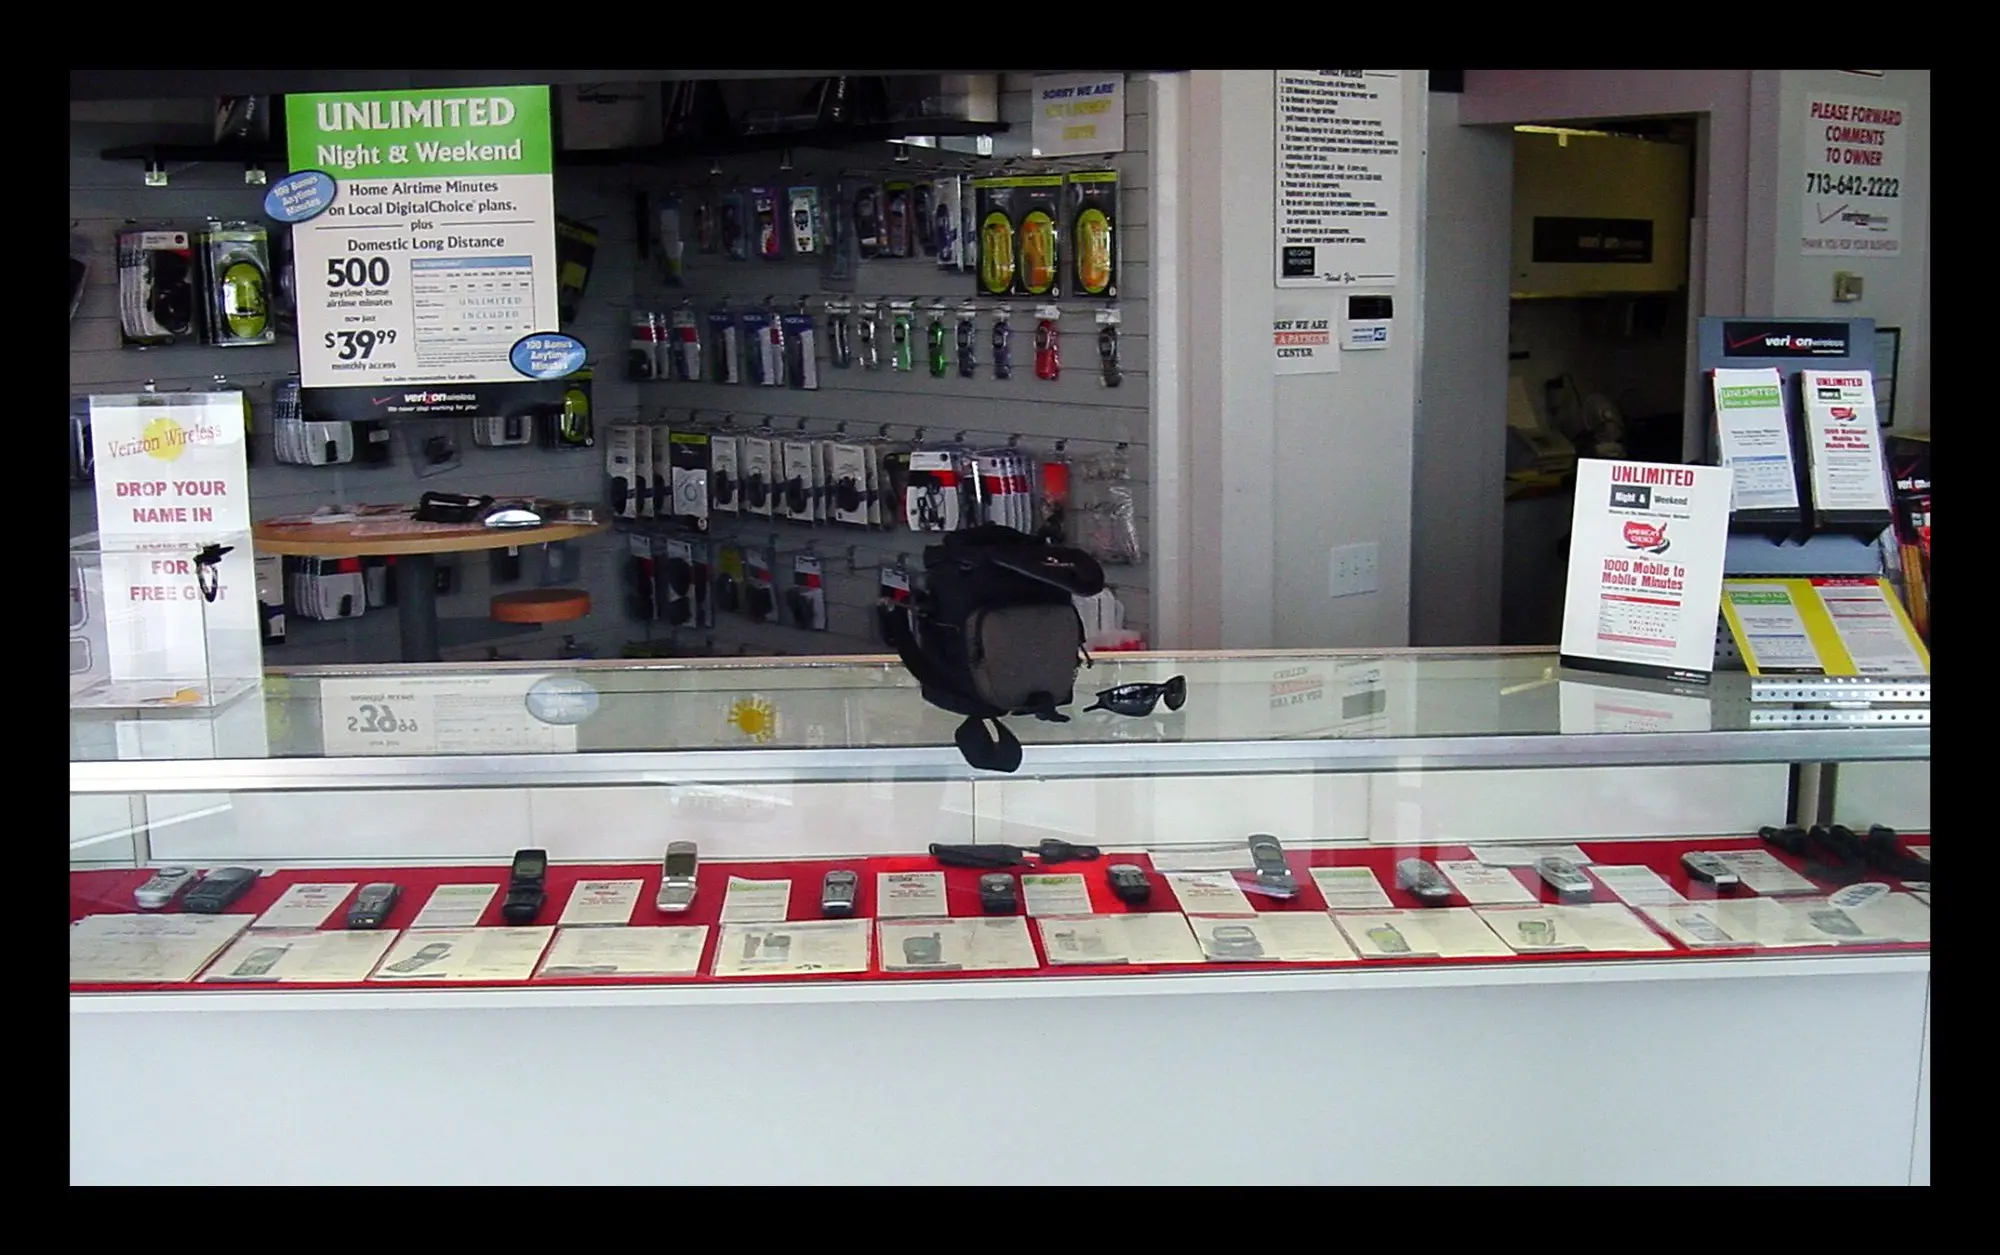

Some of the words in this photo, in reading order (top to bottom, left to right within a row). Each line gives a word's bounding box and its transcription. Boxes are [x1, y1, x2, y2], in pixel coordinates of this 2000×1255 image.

[1042, 87, 1075, 99] SORRY
[1077, 85, 1093, 96] WE
[1094, 83, 1114, 94] ARE
[317, 97, 516, 132] UNLIMITED
[1811, 102, 1849, 121] PLEASE
[1851, 106, 1902, 126] FORWARD
[1825, 125, 1886, 146] COMMENTS
[317, 142, 381, 170] Night
[388, 145, 409, 164] &
[415, 138, 523, 163] Weekend
[1826, 147, 1841, 164] TO
[1844, 148, 1883, 166] OWNER
[349, 183, 388, 197] Home
[392, 182, 442, 196] Airtime
[446, 181, 498, 194] Minutes
[1806, 173, 1900, 198] 713-642-2222
[328, 205, 344, 216] on
[349, 202, 382, 216] Local
[386, 200, 476, 217] DigitalChoice
[478, 198, 517, 214] plans.
[411, 219, 433, 232] plus
[348, 237, 409, 252] Domestic
[412, 237, 444, 251] Long
[448, 236, 504, 249] Distance
[327, 256, 390, 288] 500
[329, 289, 363, 298] anytime
[365, 288, 389, 297] home
[327, 299, 357, 308] airtime
[359, 298, 393, 307] minutes
[362, 314, 376, 323] just
[1296, 320, 1309, 329] WE
[1311, 319, 1328, 329] ARE
[1277, 347, 1313, 358] CENTER
[331, 361, 366, 371] monthly
[369, 361, 396, 369] access
[1816, 377, 1863, 387] UNLIMITED
[108, 436, 160, 459] Verizon
[165, 424, 222, 446] Wireless
[1612, 465, 1694, 487] UNLIMITED
[116, 481, 168, 497] DROP
[173, 480, 227, 496] YOUR
[1615, 491, 1636, 503] Night
[1654, 494, 1688, 506] Weekend
[133, 507, 187, 523] NAME
[193, 507, 213, 522] IN
[152, 560, 190, 575] FOR
[1604, 559, 1629, 573] 1000
[1633, 561, 1670, 576] Mobile
[1674, 565, 1685, 577] to
[1602, 571, 1637, 586] Mobile
[1641, 575, 1684, 590] Minutes
[130, 586, 177, 601] FREE
